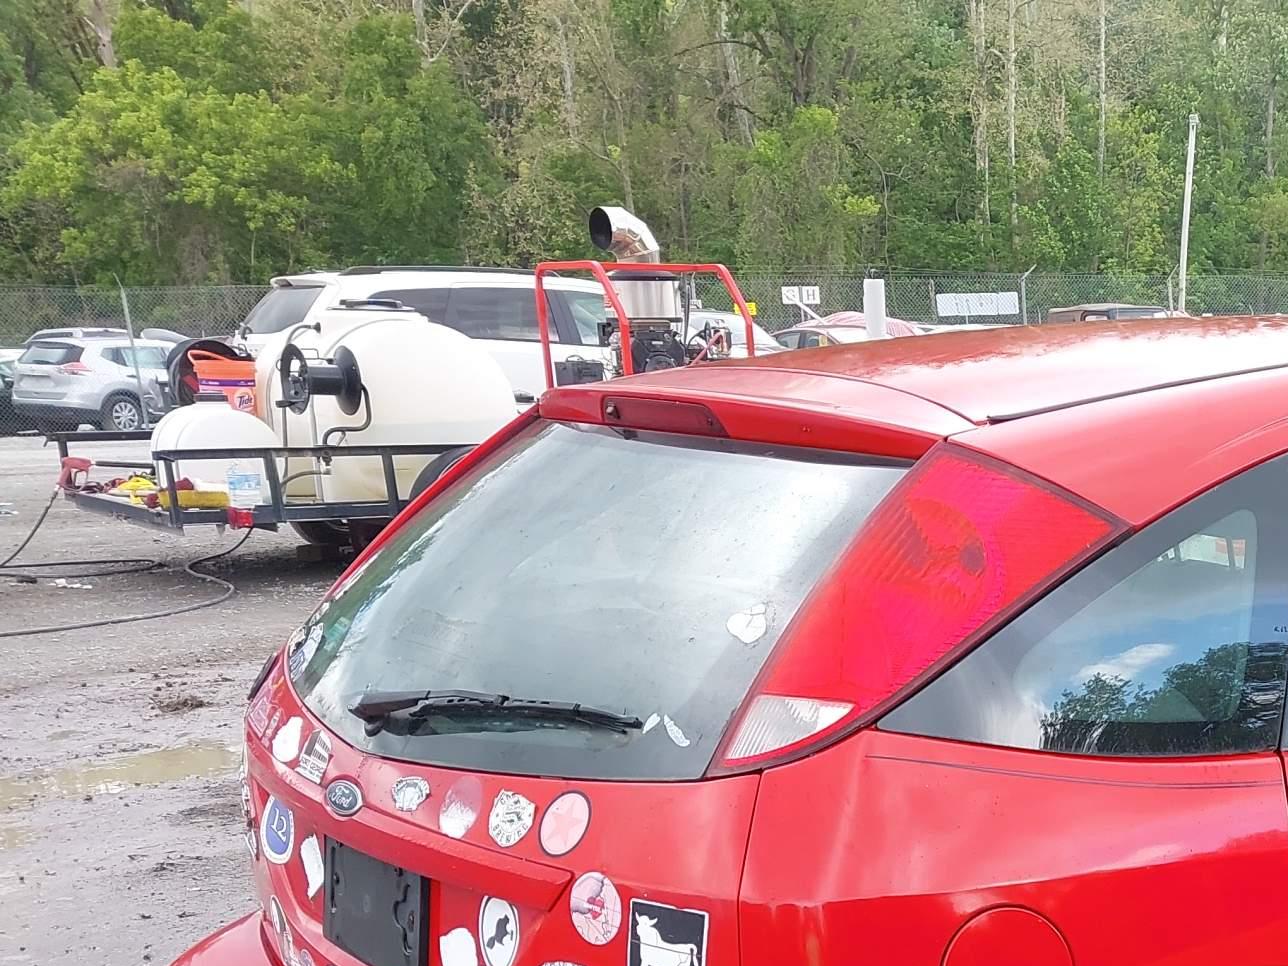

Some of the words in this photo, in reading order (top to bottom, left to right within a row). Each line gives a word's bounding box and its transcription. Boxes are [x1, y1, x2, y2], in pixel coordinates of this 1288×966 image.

[806, 289, 815, 301] H
[238, 394, 253, 408] Tide
[328, 785, 353, 808] Ford
[270, 807, 287, 843] 12
